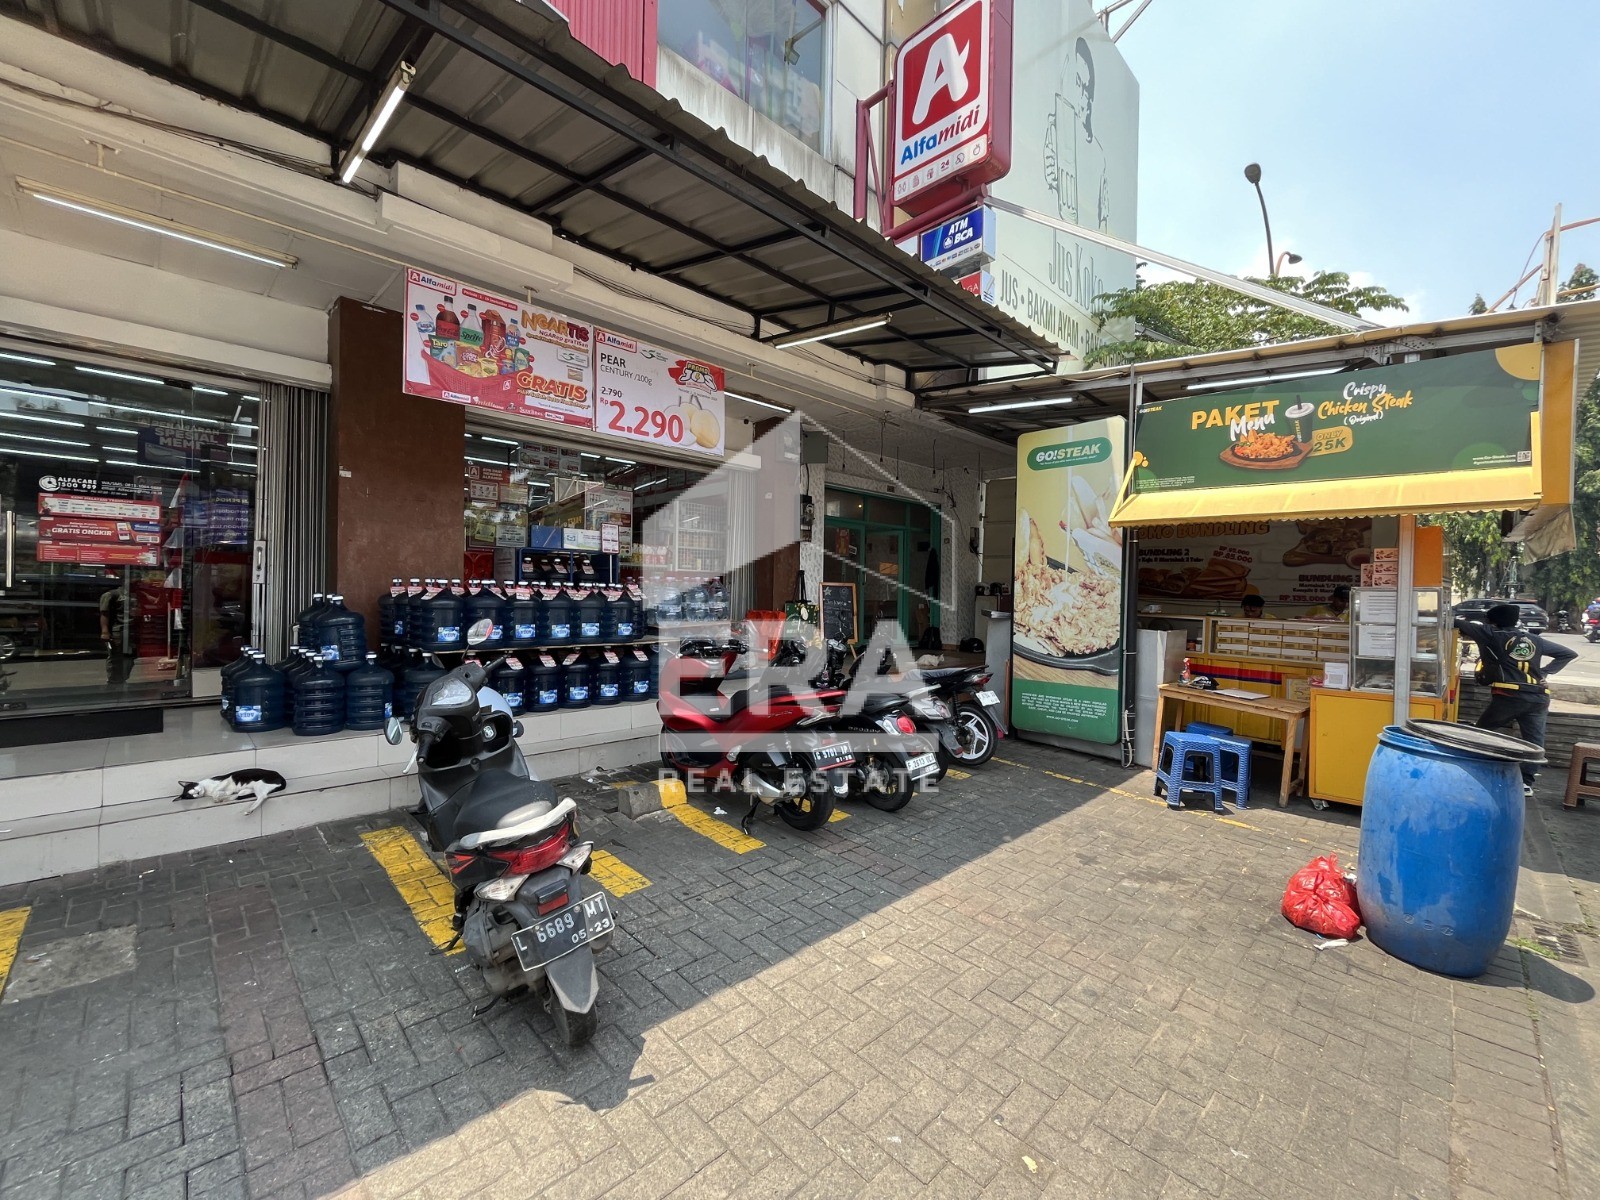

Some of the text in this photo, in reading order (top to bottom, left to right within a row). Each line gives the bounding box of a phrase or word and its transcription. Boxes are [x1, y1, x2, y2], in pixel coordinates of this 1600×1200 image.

[900, 104, 980, 166] Alfamidi
[948, 217, 969, 236] ATM
[953, 227, 973, 245] BCA
[420, 276, 455, 292] Alfamidi
[1000, 269, 1019, 310] JUS
[1027, 287, 1056, 335] BAKMI
[1057, 310, 1079, 350] AYAM
[521, 309, 590, 343] NGARTIS
[431, 337, 448, 348] Taro
[460, 330, 484, 345] Sprite
[606, 336, 634, 350] Alfamidi
[600, 352, 627, 369] PEAR
[600, 364, 653, 387] CENTURY /100g
[516, 371, 588, 402] GRATIS
[601, 386, 623, 398] 2.790
[1343, 382, 1387, 400] Crispy
[1317, 390, 1414, 420] Chicken Steak
[600, 397, 609, 406] Rp
[608, 400, 684, 443] 2.290
[1191, 399, 1280, 430] PAKET
[155, 427, 219, 444] SPESIAL
[1230, 412, 1276, 442] Menu
[1315, 430, 1343, 442] ONLY
[1036, 442, 1102, 463] GO!STEAK
[1312, 436, 1347, 453] 25K
[57, 476, 97, 485] ALFACARE
[51, 527, 80, 535] GRATIS
[1177, 519, 1270, 538] BUNDLING
[1298, 574, 1353, 583] BUNDLING
[515, 896, 607, 952] L 6689 MT
